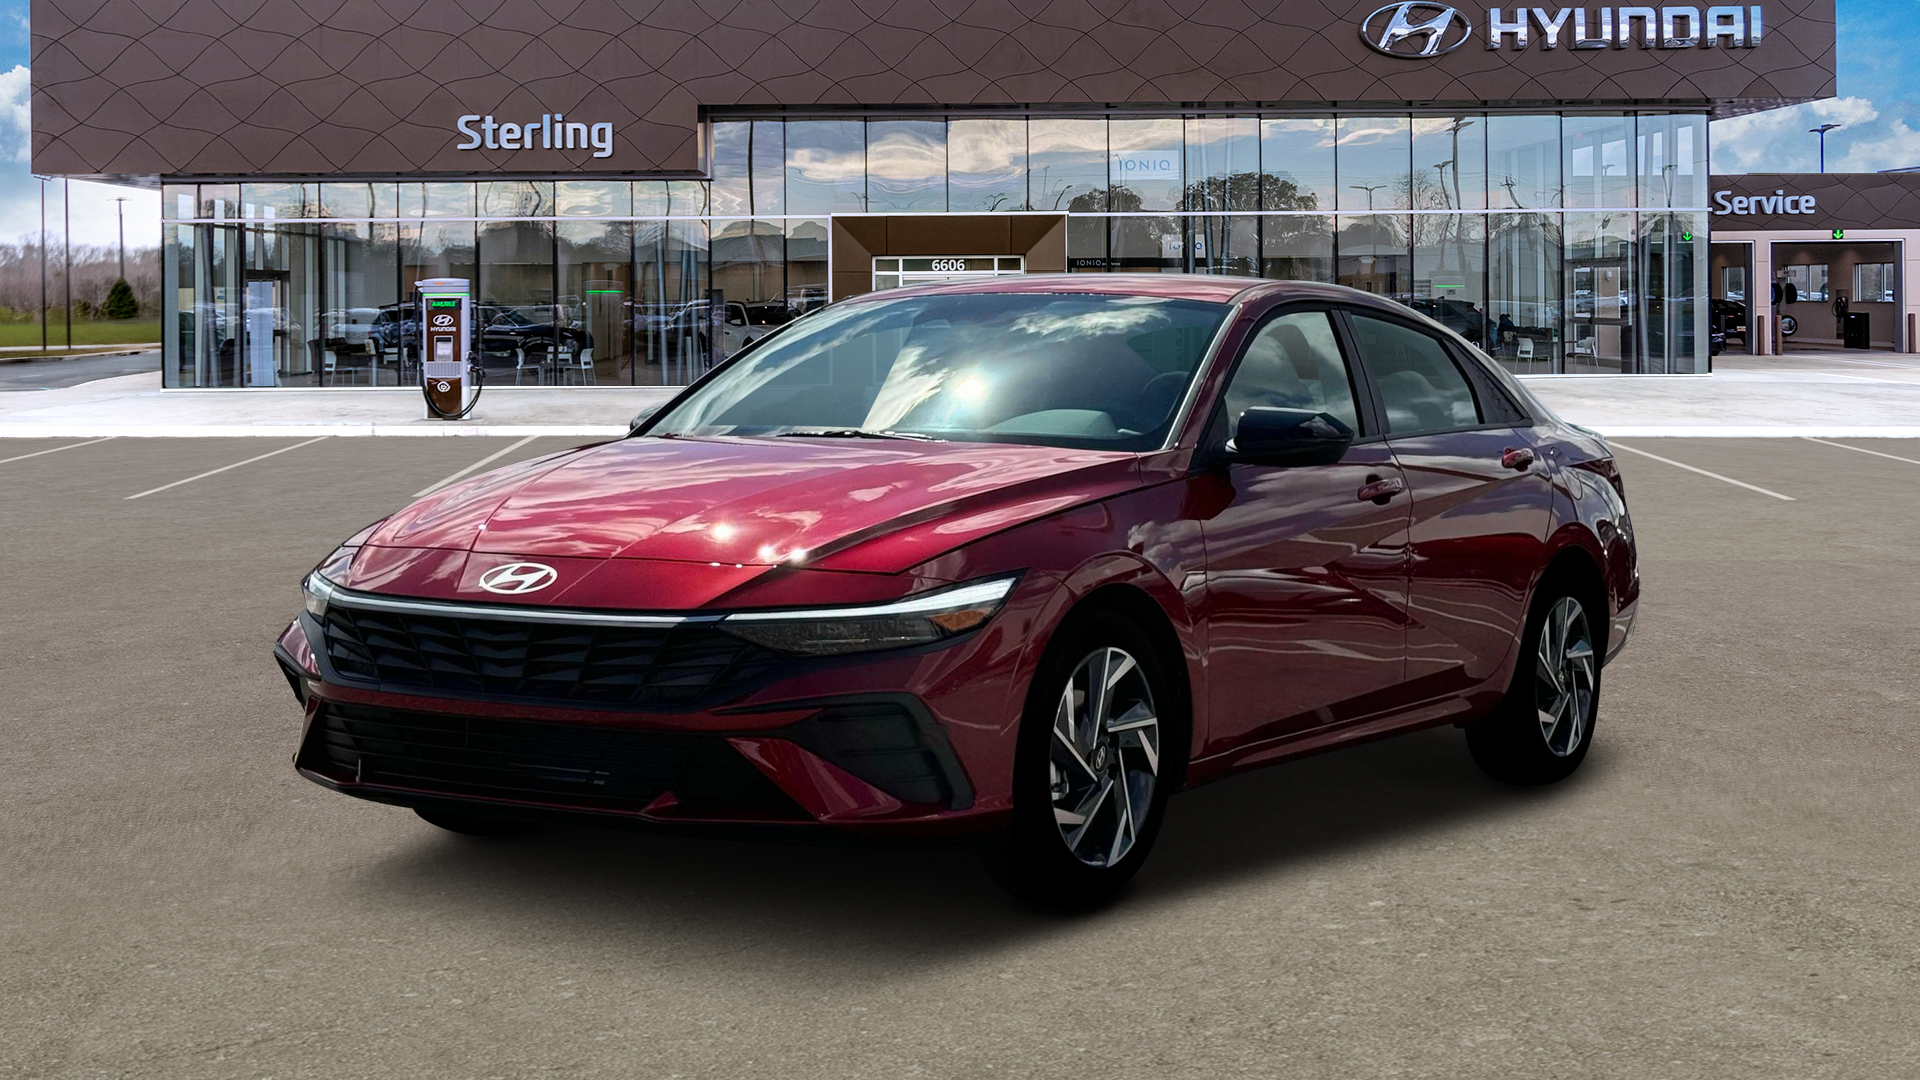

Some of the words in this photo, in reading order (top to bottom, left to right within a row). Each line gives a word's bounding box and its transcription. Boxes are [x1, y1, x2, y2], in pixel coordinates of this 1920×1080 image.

[1486, 5, 1762, 50] HYUNDAI
[456, 113, 614, 158] Sterling
[1119, 159, 1170, 171] IONIQ
[1713, 189, 1816, 215] Service
[1168, 241, 1203, 251] IOQ
[931, 259, 966, 272] 6606
